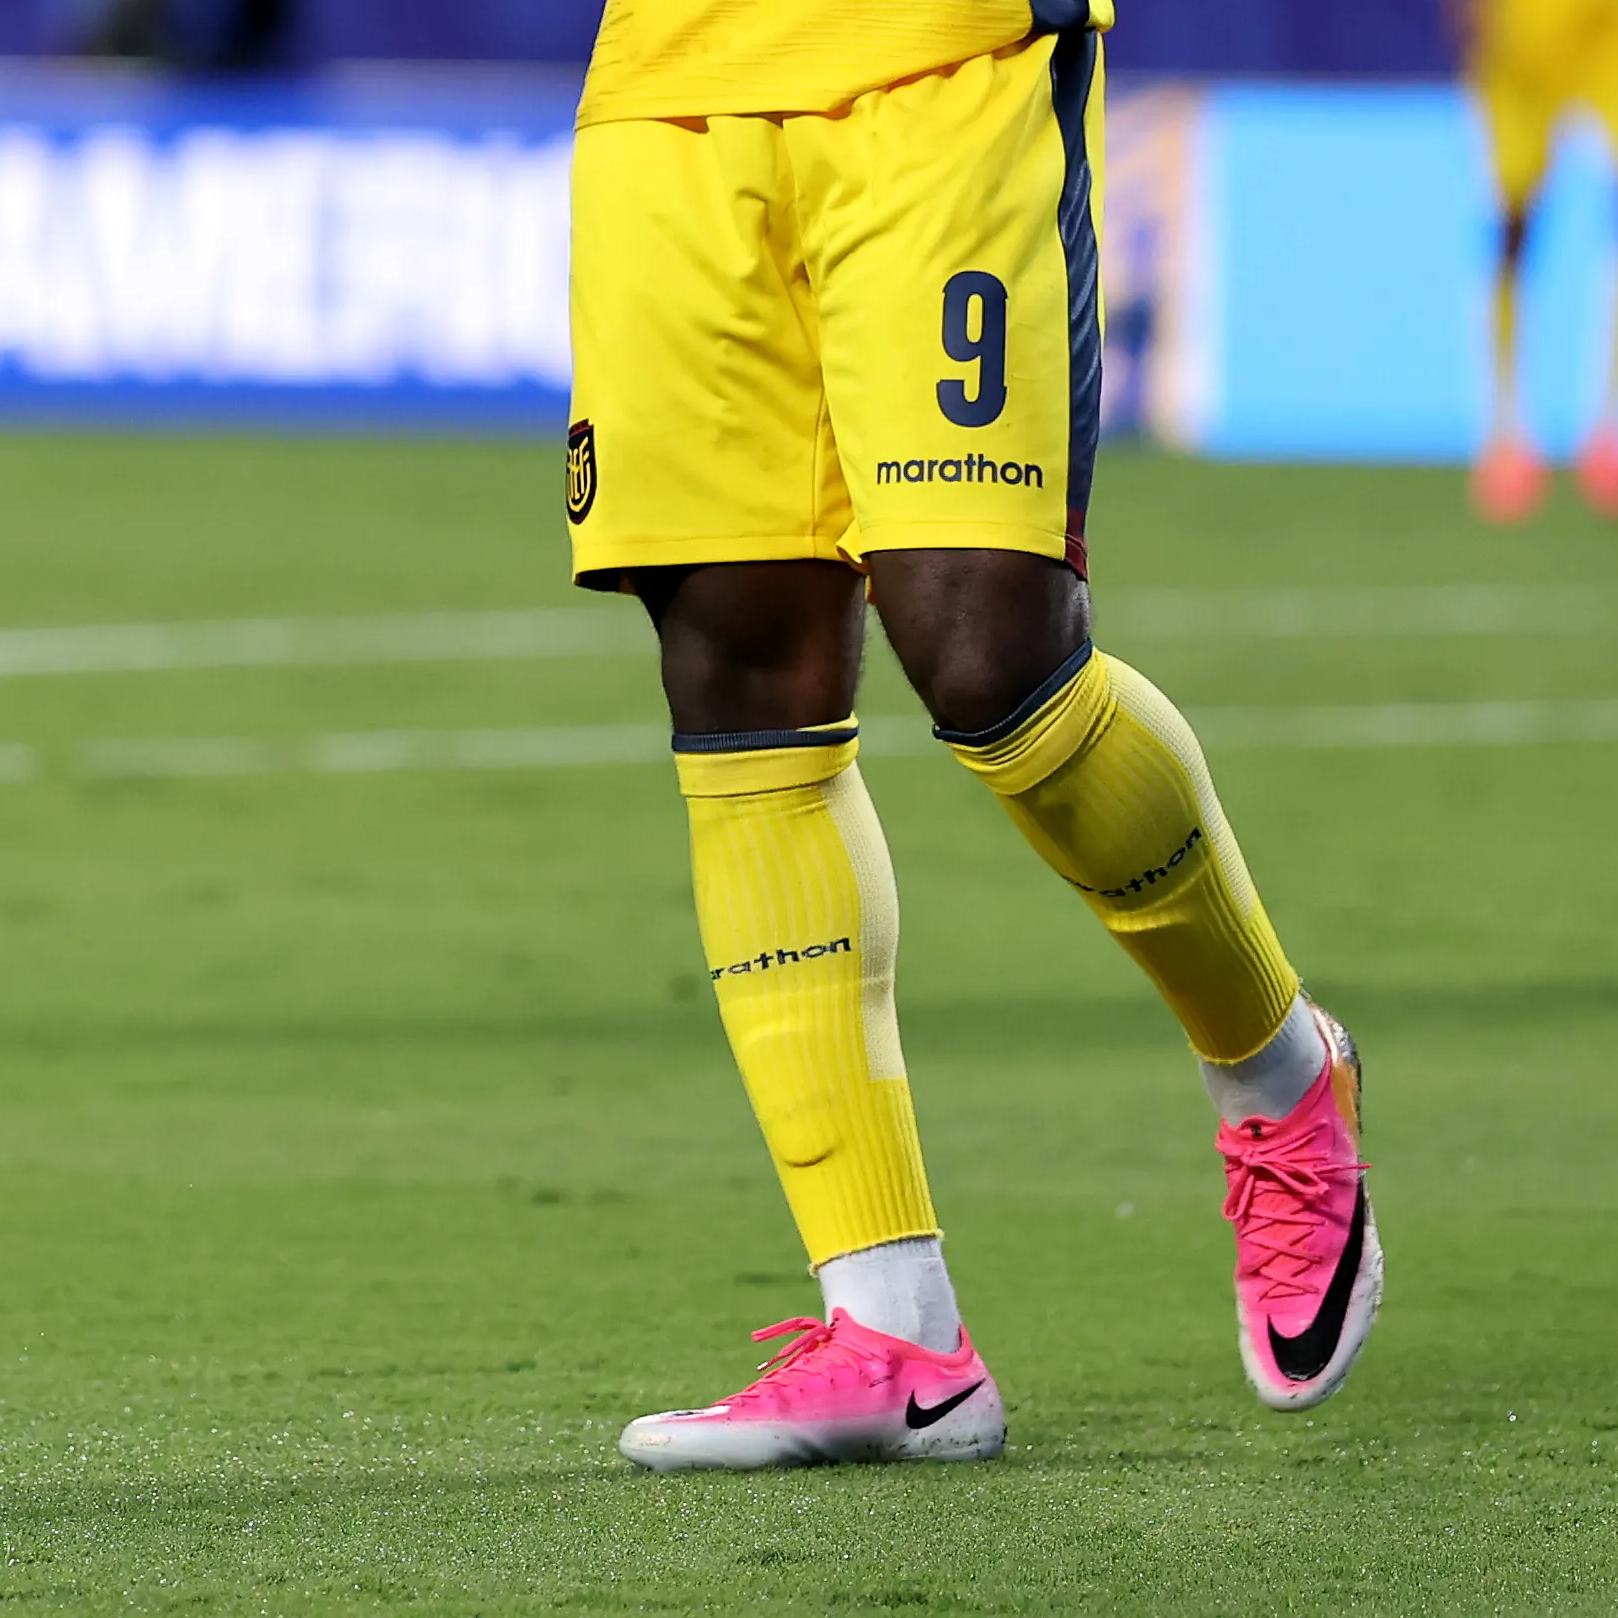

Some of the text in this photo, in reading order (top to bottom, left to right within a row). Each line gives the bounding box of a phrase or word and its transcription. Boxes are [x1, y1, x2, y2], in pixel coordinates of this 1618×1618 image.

[936, 270, 1009, 428] 9
[877, 453, 1043, 489] marathon
[710, 937, 851, 980] rathon
